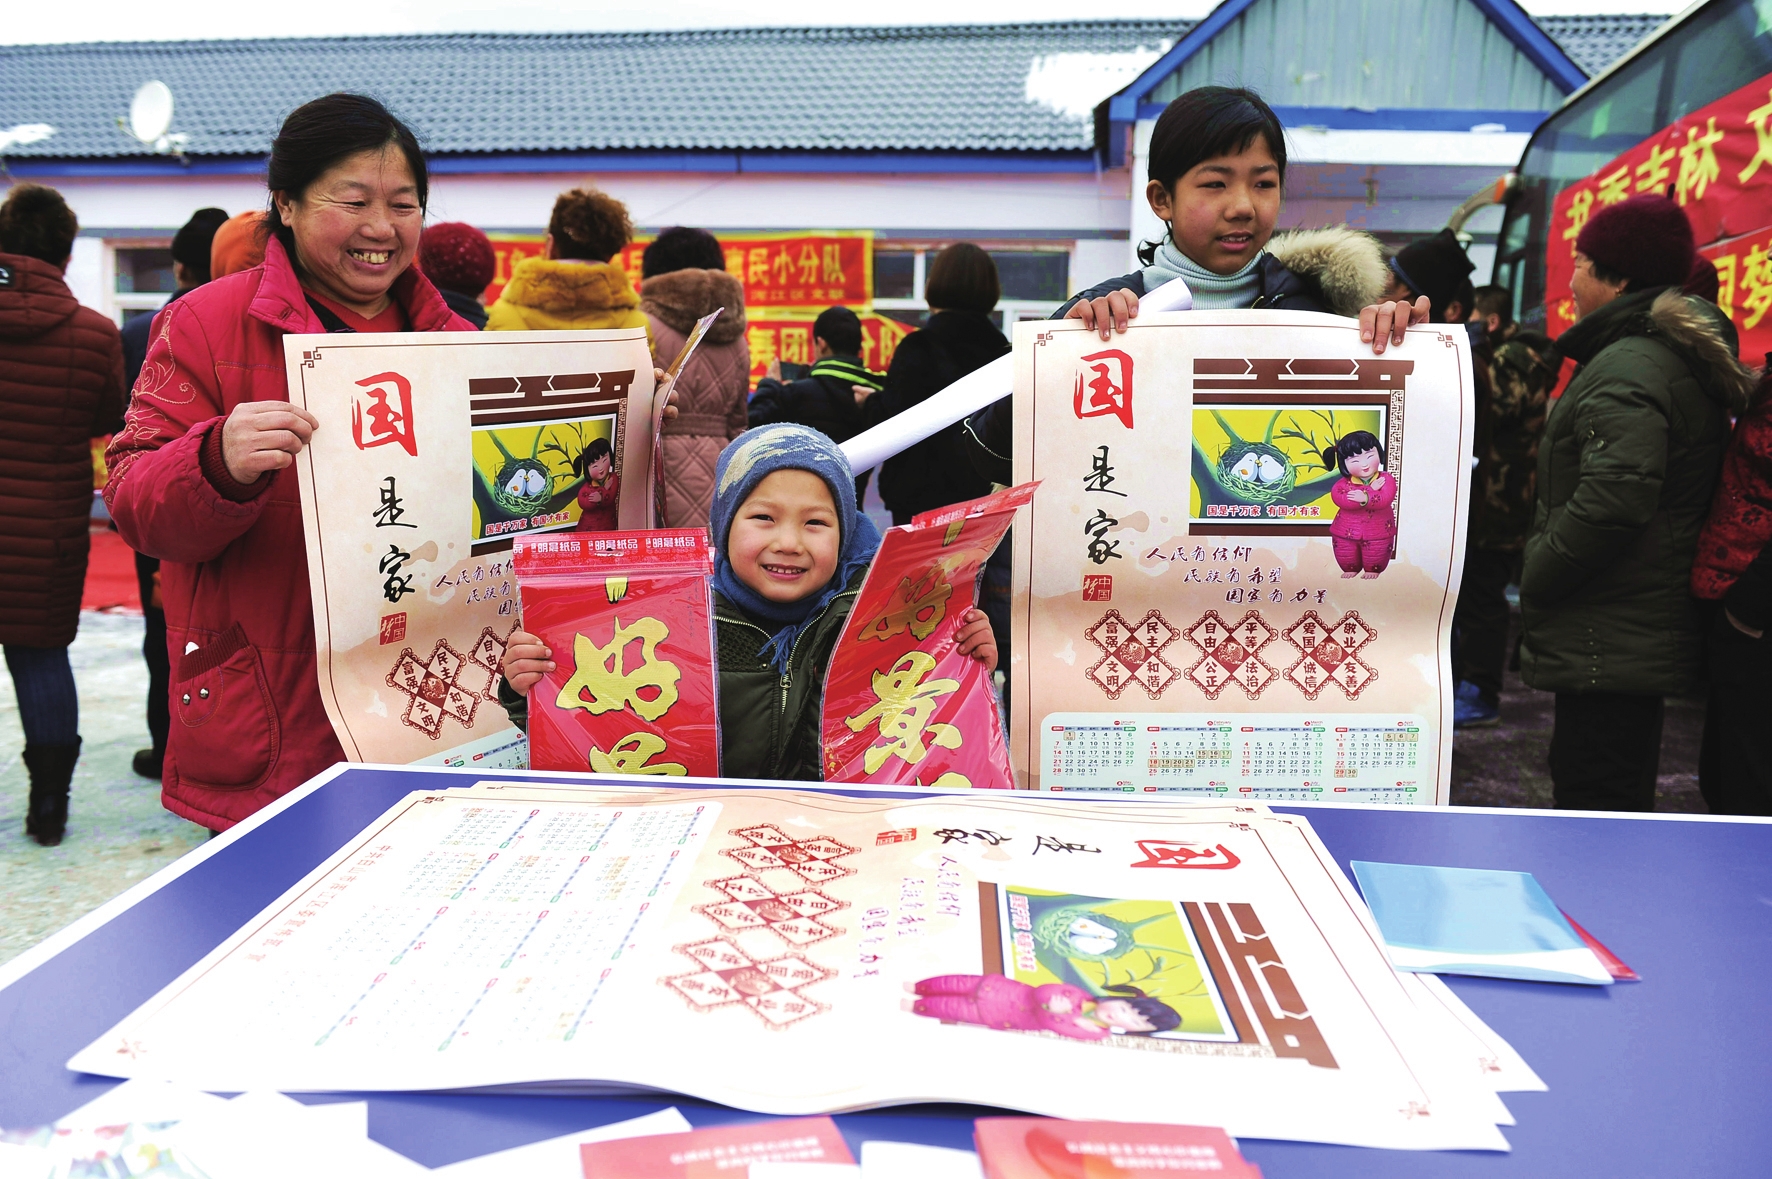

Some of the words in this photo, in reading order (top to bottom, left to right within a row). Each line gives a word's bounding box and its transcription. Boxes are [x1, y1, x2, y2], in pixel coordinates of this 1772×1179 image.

[1074, 349, 1134, 564] 国是家
[351, 371, 418, 603] 国是家
[485, 517, 527, 536] 国是千万家
[531, 510, 570, 527] 有国才有家
[1206, 504, 1261, 517] 国是千万家
[1267, 504, 1321, 517] 有国才有家
[1146, 545, 1252, 563] 人民有信仰
[1185, 566, 1281, 585] 民族有希望
[1226, 587, 1327, 604] 国家有力量
[1105, 622, 1119, 648] 富强
[1146, 622, 1159, 649] 民主
[1204, 622, 1217, 649] 自由
[1245, 622, 1258, 649] 平等
[1303, 622, 1316, 649] 爱国
[1343, 622, 1357, 649] 敬业
[437, 651, 453, 681] 民主
[483, 640, 497, 666] 自由
[401, 659, 418, 690] 富强
[1106, 661, 1120, 689] 文明
[1146, 661, 1160, 688] 和谐
[1204, 661, 1218, 688] 公正
[1245, 661, 1259, 688] 法治
[1303, 661, 1317, 689] 诚信
[1343, 661, 1358, 689] 友善
[415, 700, 435, 727] 文明
[449, 691, 469, 717] 和谐
